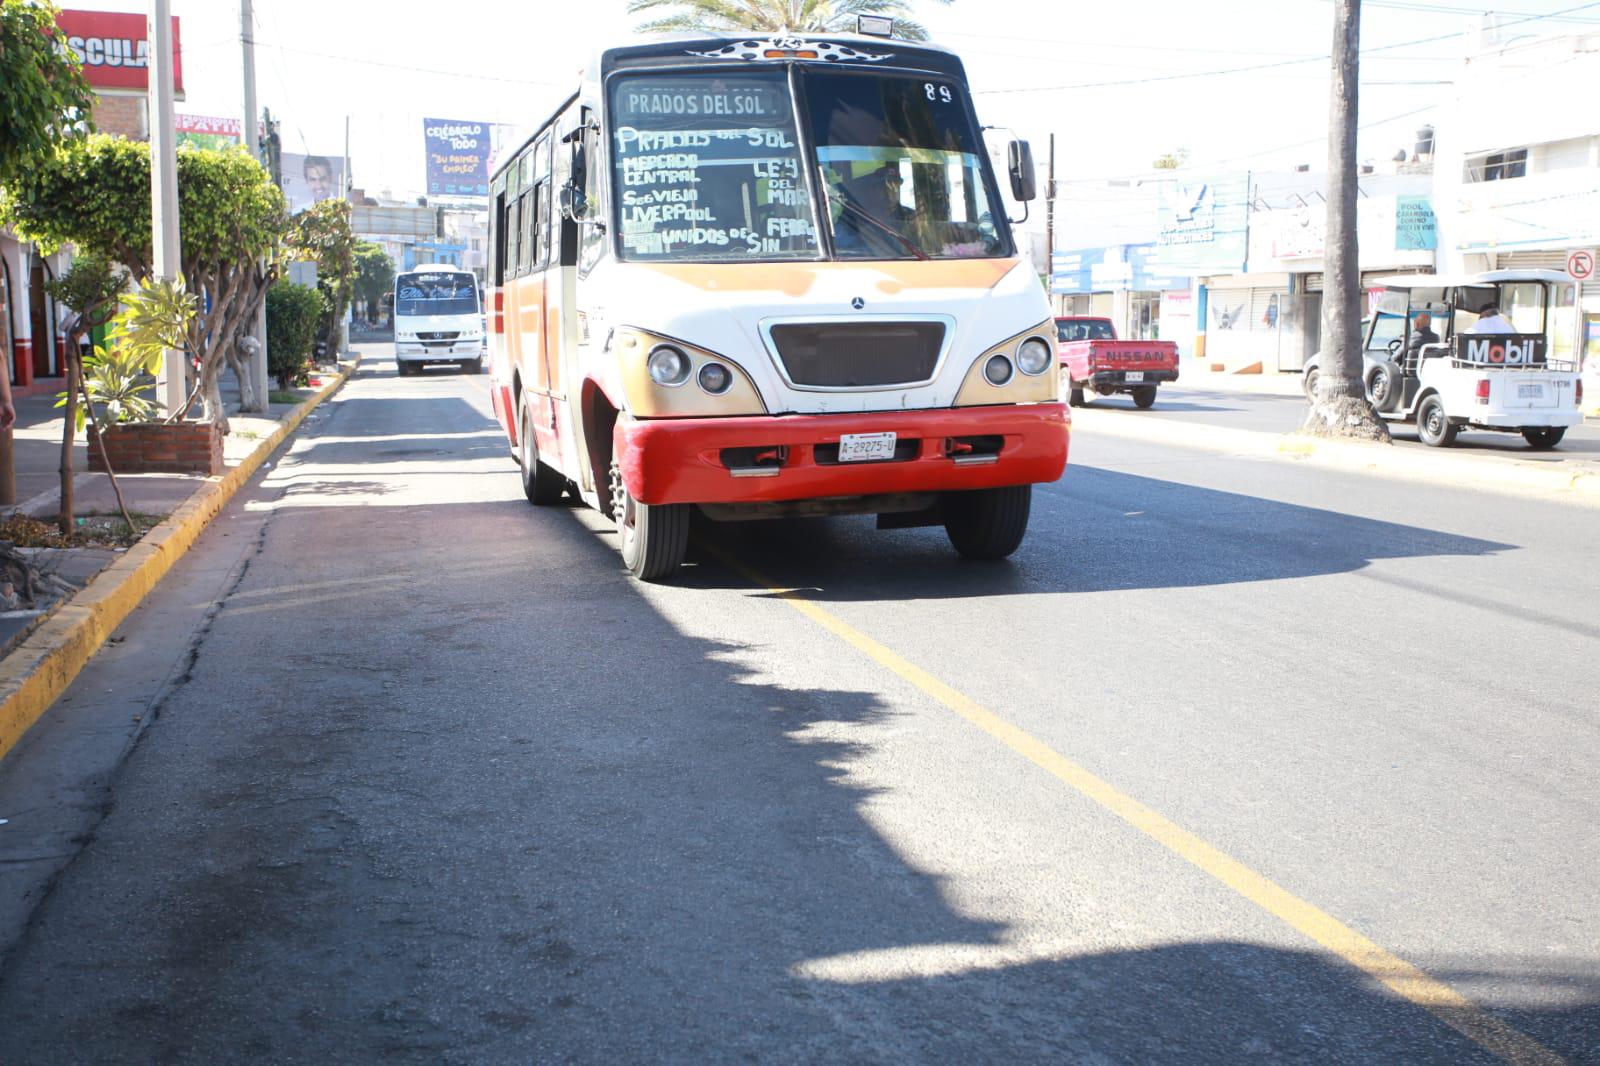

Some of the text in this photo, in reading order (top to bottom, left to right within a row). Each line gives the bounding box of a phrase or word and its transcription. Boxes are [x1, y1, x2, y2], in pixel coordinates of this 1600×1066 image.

[924, 83, 952, 102] 89
[629, 94, 765, 115] PRADOS DEL SOL
[617, 127, 711, 152] PRADOS
[748, 128, 795, 148] SOL
[622, 154, 699, 172] MERCADO
[753, 158, 799, 179] LEY
[624, 169, 701, 186] CENTRAL
[768, 179, 795, 189] DEL
[767, 189, 810, 206] MAR
[621, 203, 717, 223] LIVERPOOL
[746, 232, 781, 253] SIN
[1106, 351, 1164, 361] NISSAN
[1467, 339, 1534, 364] Mobil
